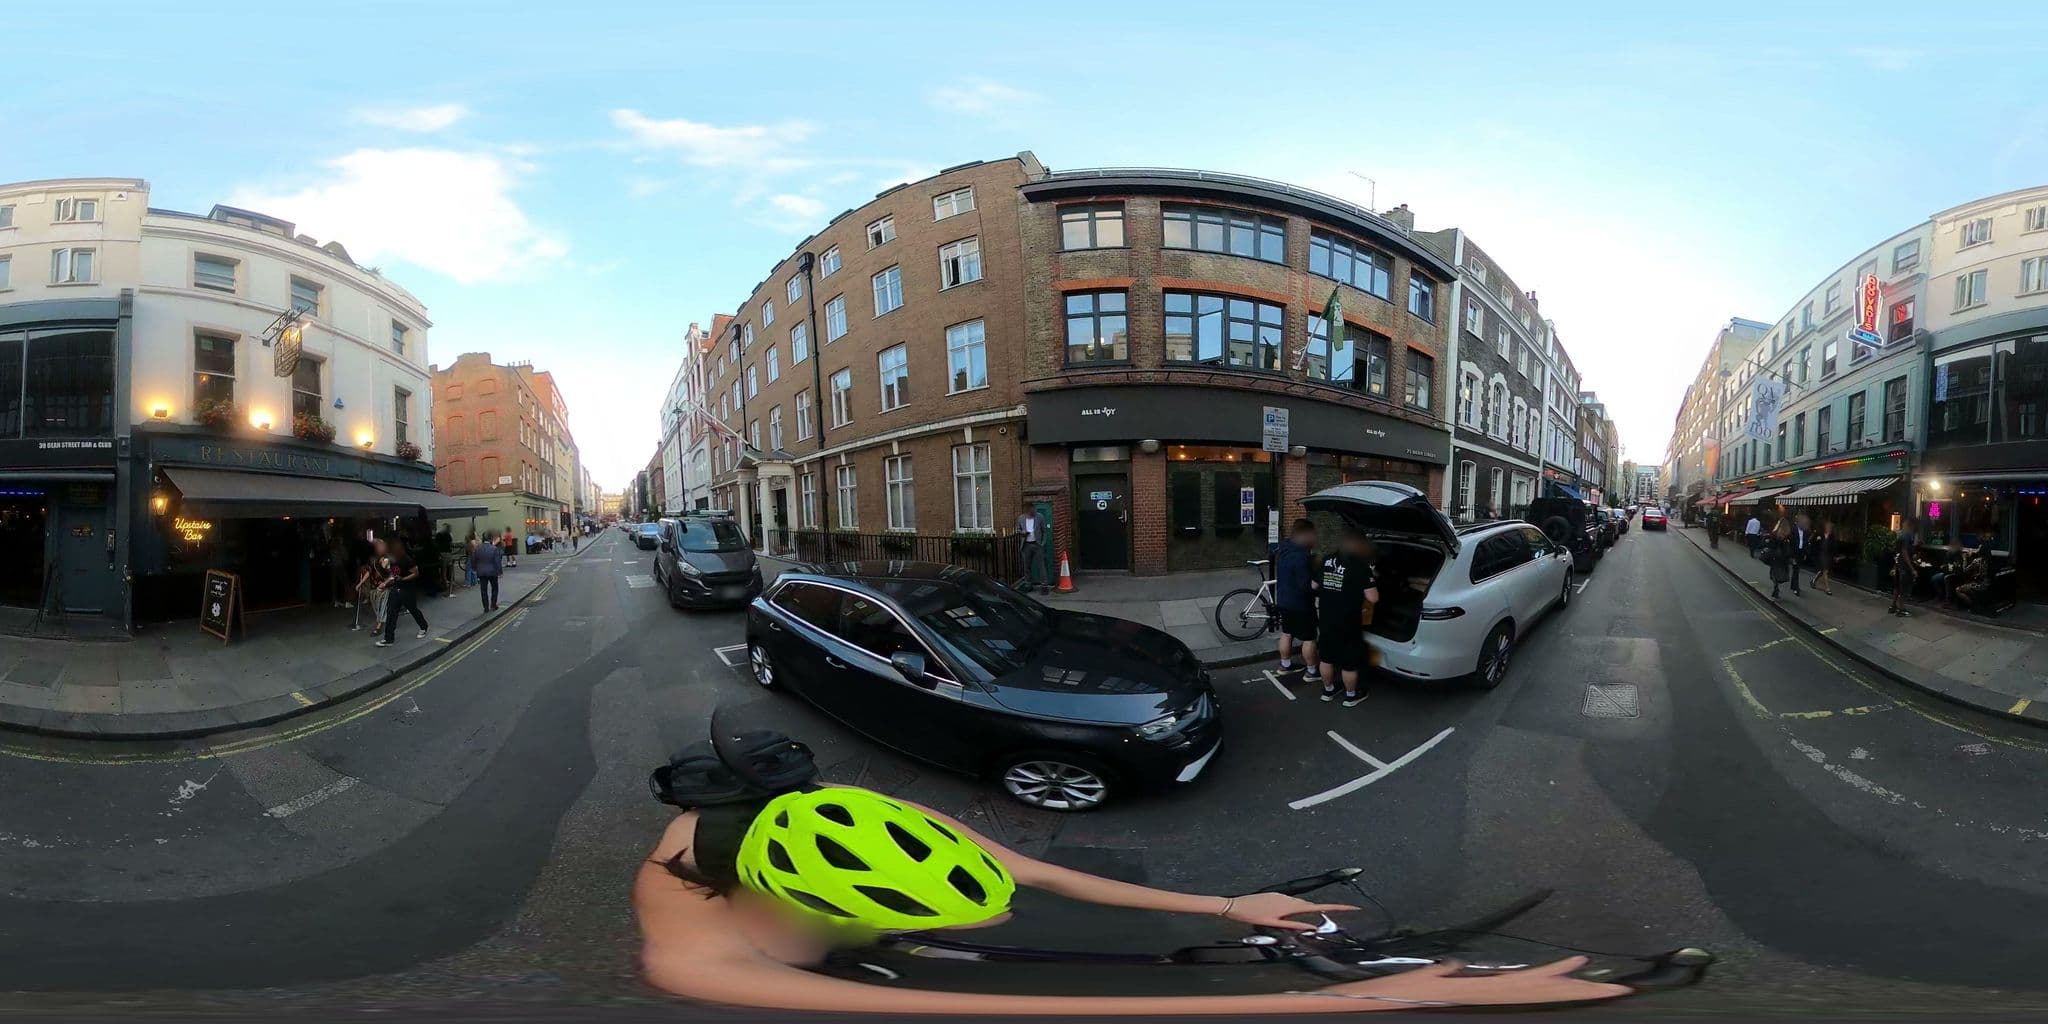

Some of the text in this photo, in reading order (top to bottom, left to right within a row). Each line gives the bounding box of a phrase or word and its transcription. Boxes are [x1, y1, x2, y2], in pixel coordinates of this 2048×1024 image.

[1101, 406, 1116, 417] JOY
[61, 441, 81, 449] STREET
[201, 445, 330, 472] RESTAURANT
[184, 529, 203, 541] Bar
